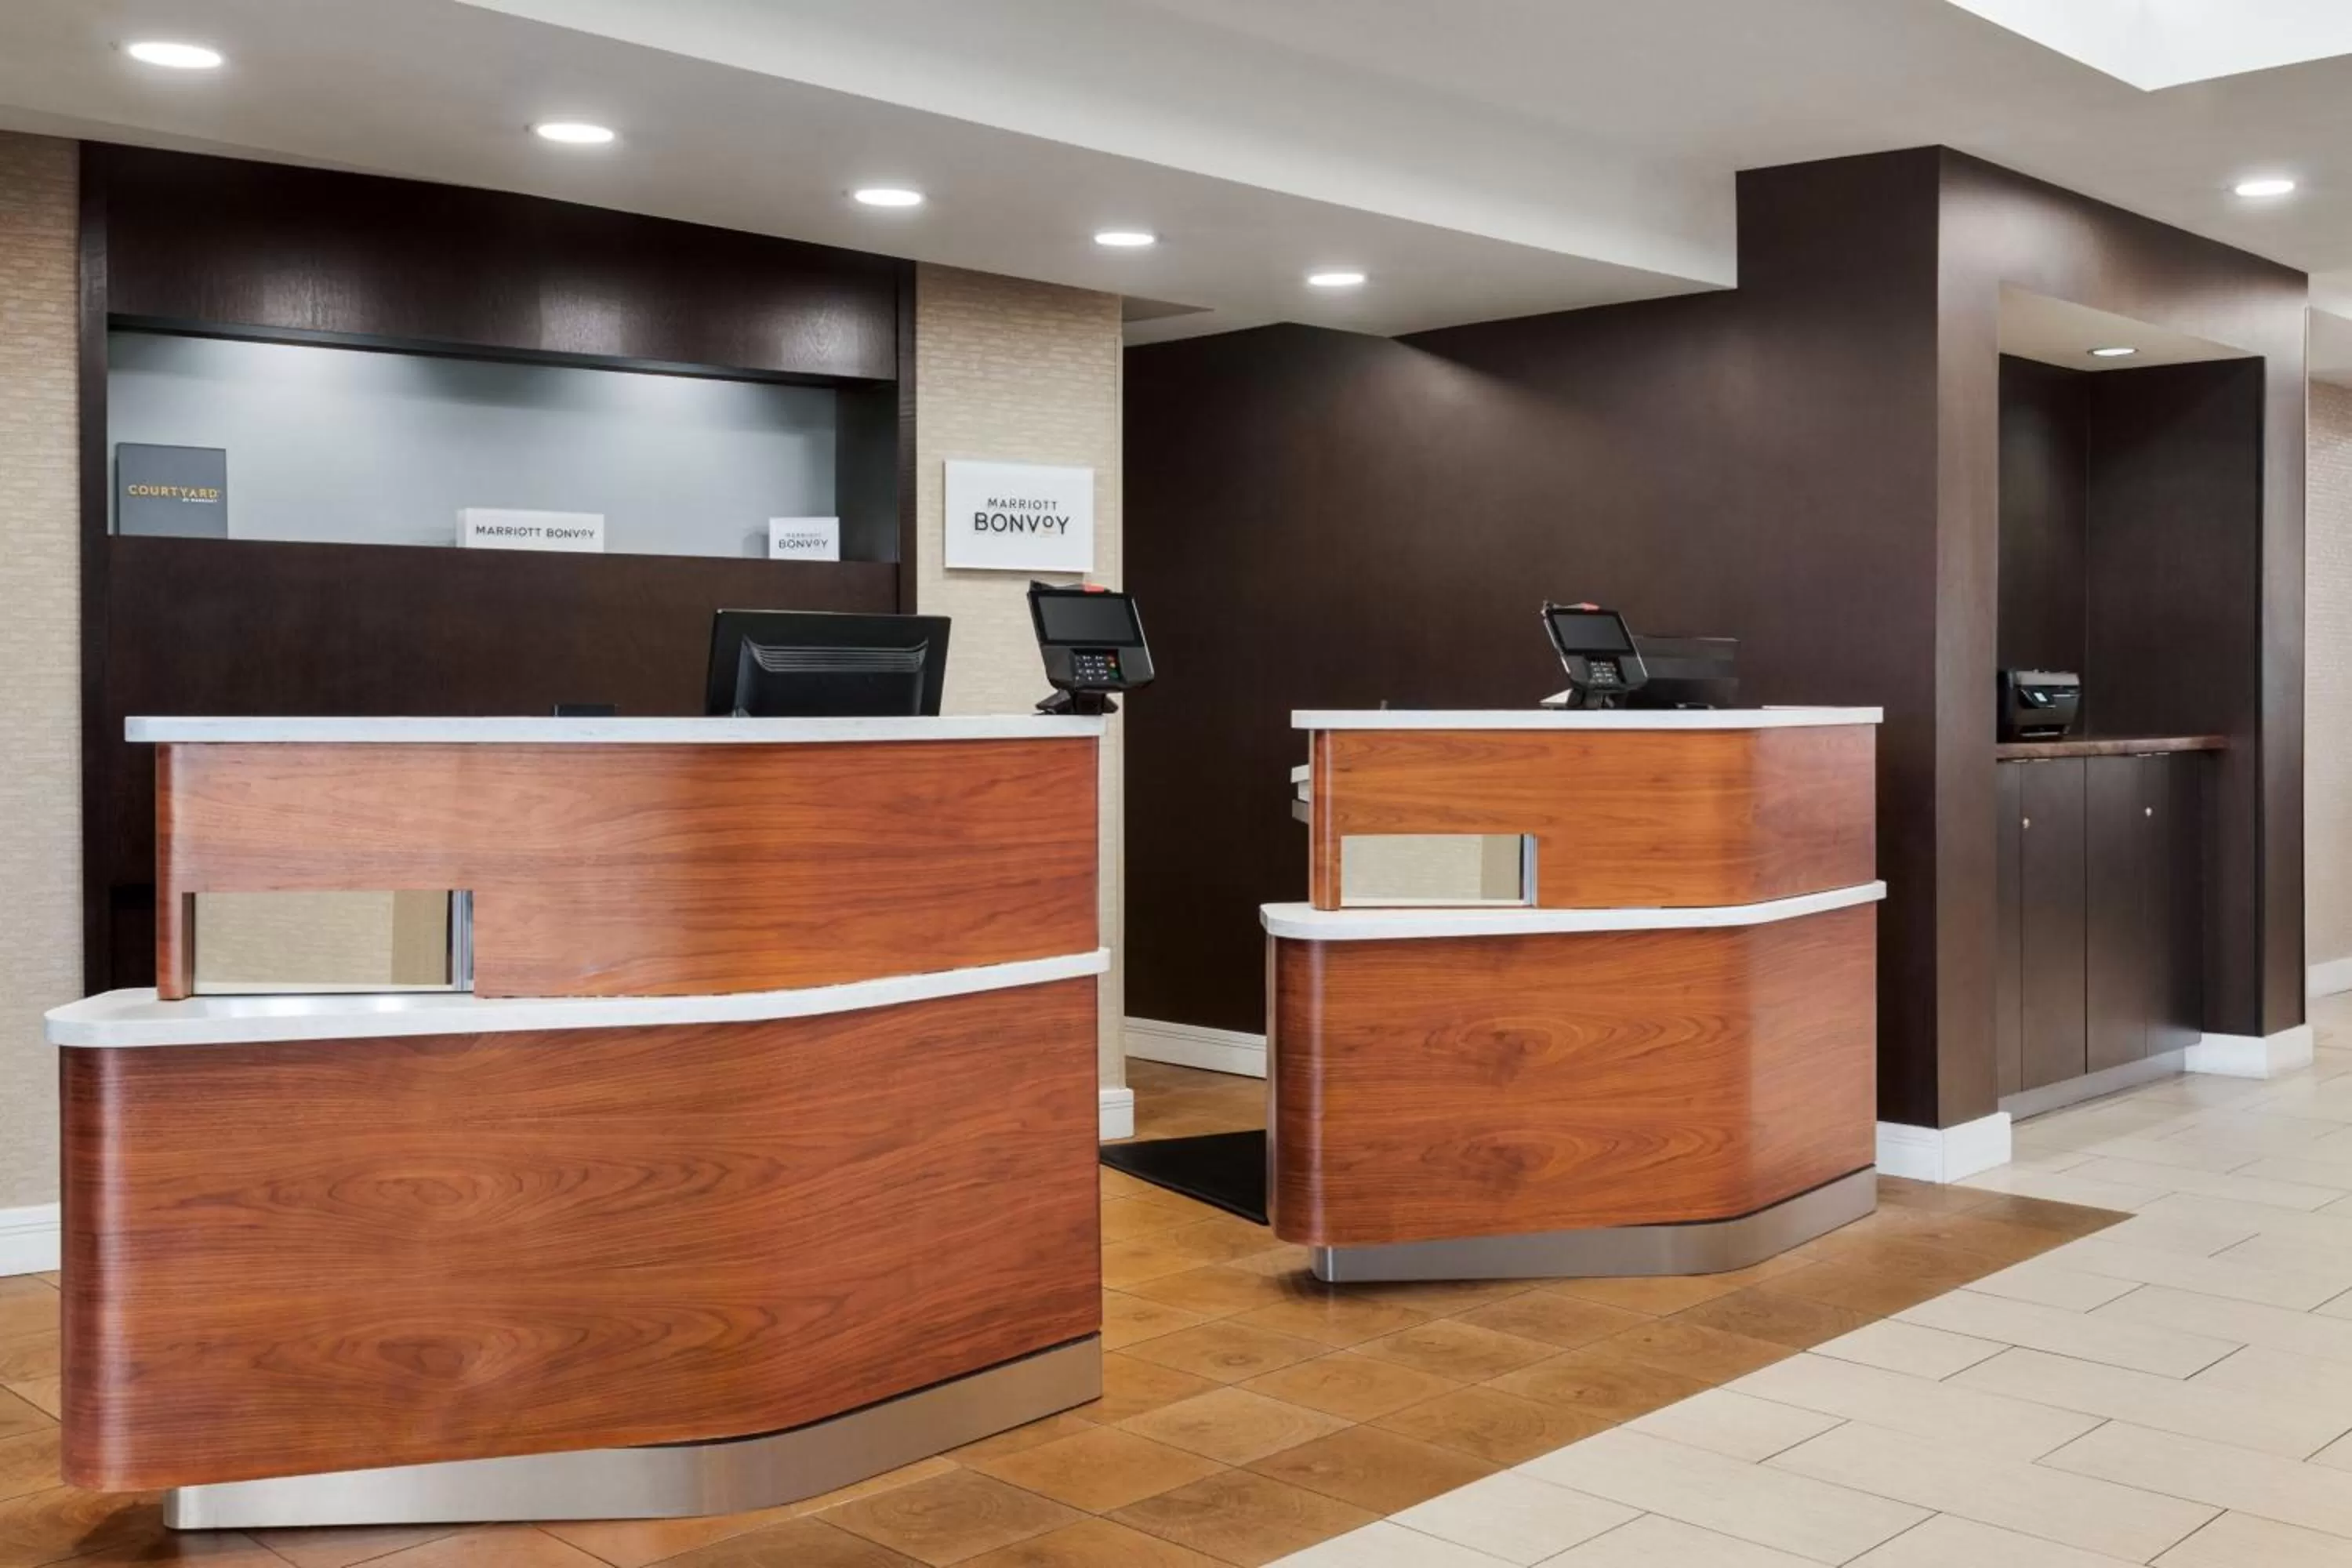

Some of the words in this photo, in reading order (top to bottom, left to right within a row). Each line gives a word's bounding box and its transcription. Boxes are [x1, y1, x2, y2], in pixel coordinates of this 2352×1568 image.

[128, 485, 217, 498] COURTYARD
[987, 498, 1058, 510] MARRIOTT
[476, 524, 542, 537] MARRIOTT
